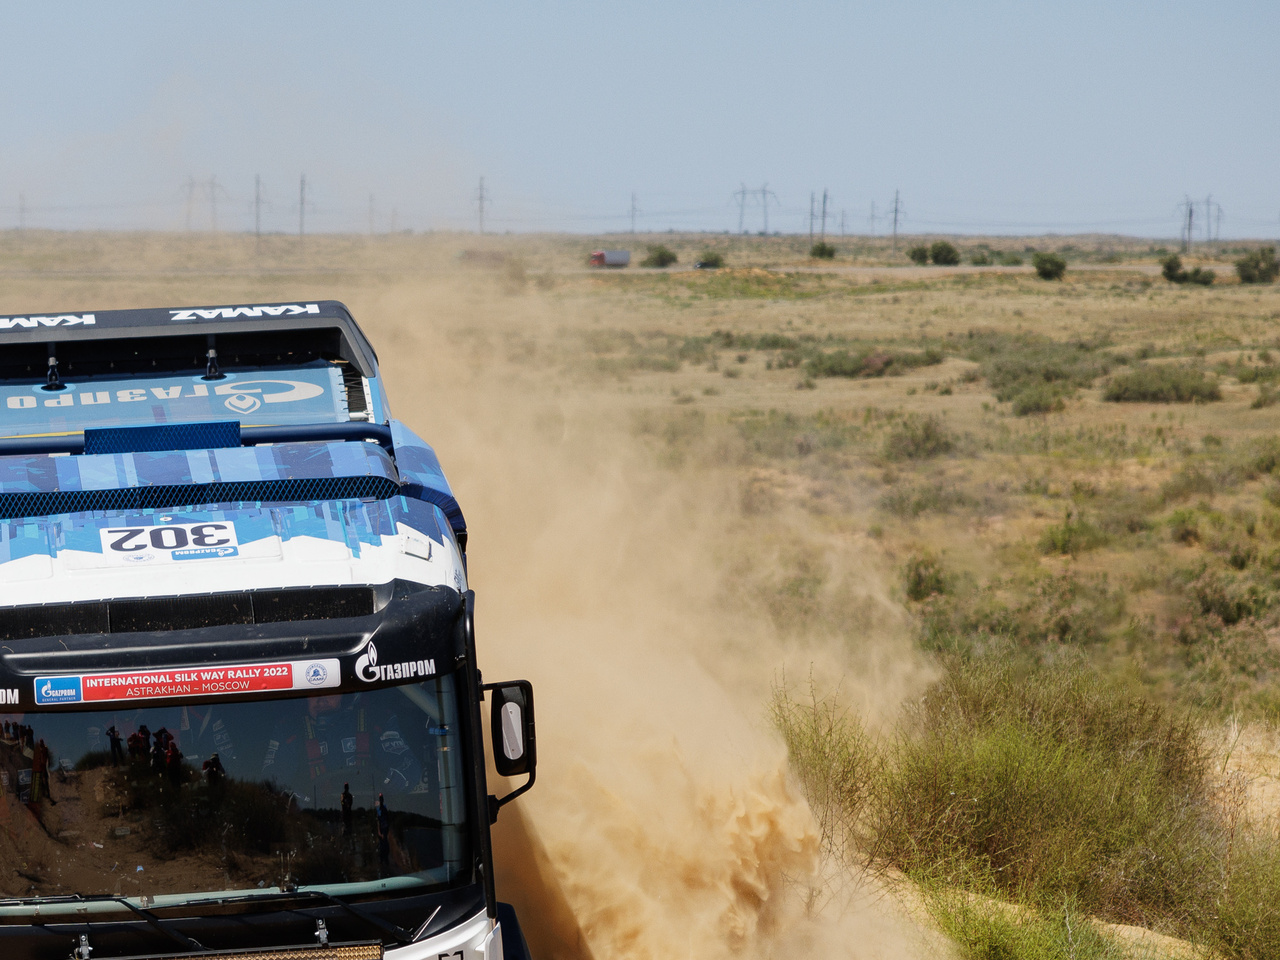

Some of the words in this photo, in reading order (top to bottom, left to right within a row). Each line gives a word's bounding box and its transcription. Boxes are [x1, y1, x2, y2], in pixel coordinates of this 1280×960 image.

[169, 303, 320, 321] KAMAZ
[108, 524, 230, 552] 302
[86, 674, 172, 687] INTERNATIONAL
[174, 672, 198, 682] SILK
[200, 671, 226, 681] WAY
[228, 669, 262, 679] RALLY
[263, 667, 288, 677] 2022
[125, 684, 191, 696] ASTRAKHAN
[202, 681, 250, 692] MOSCOW
